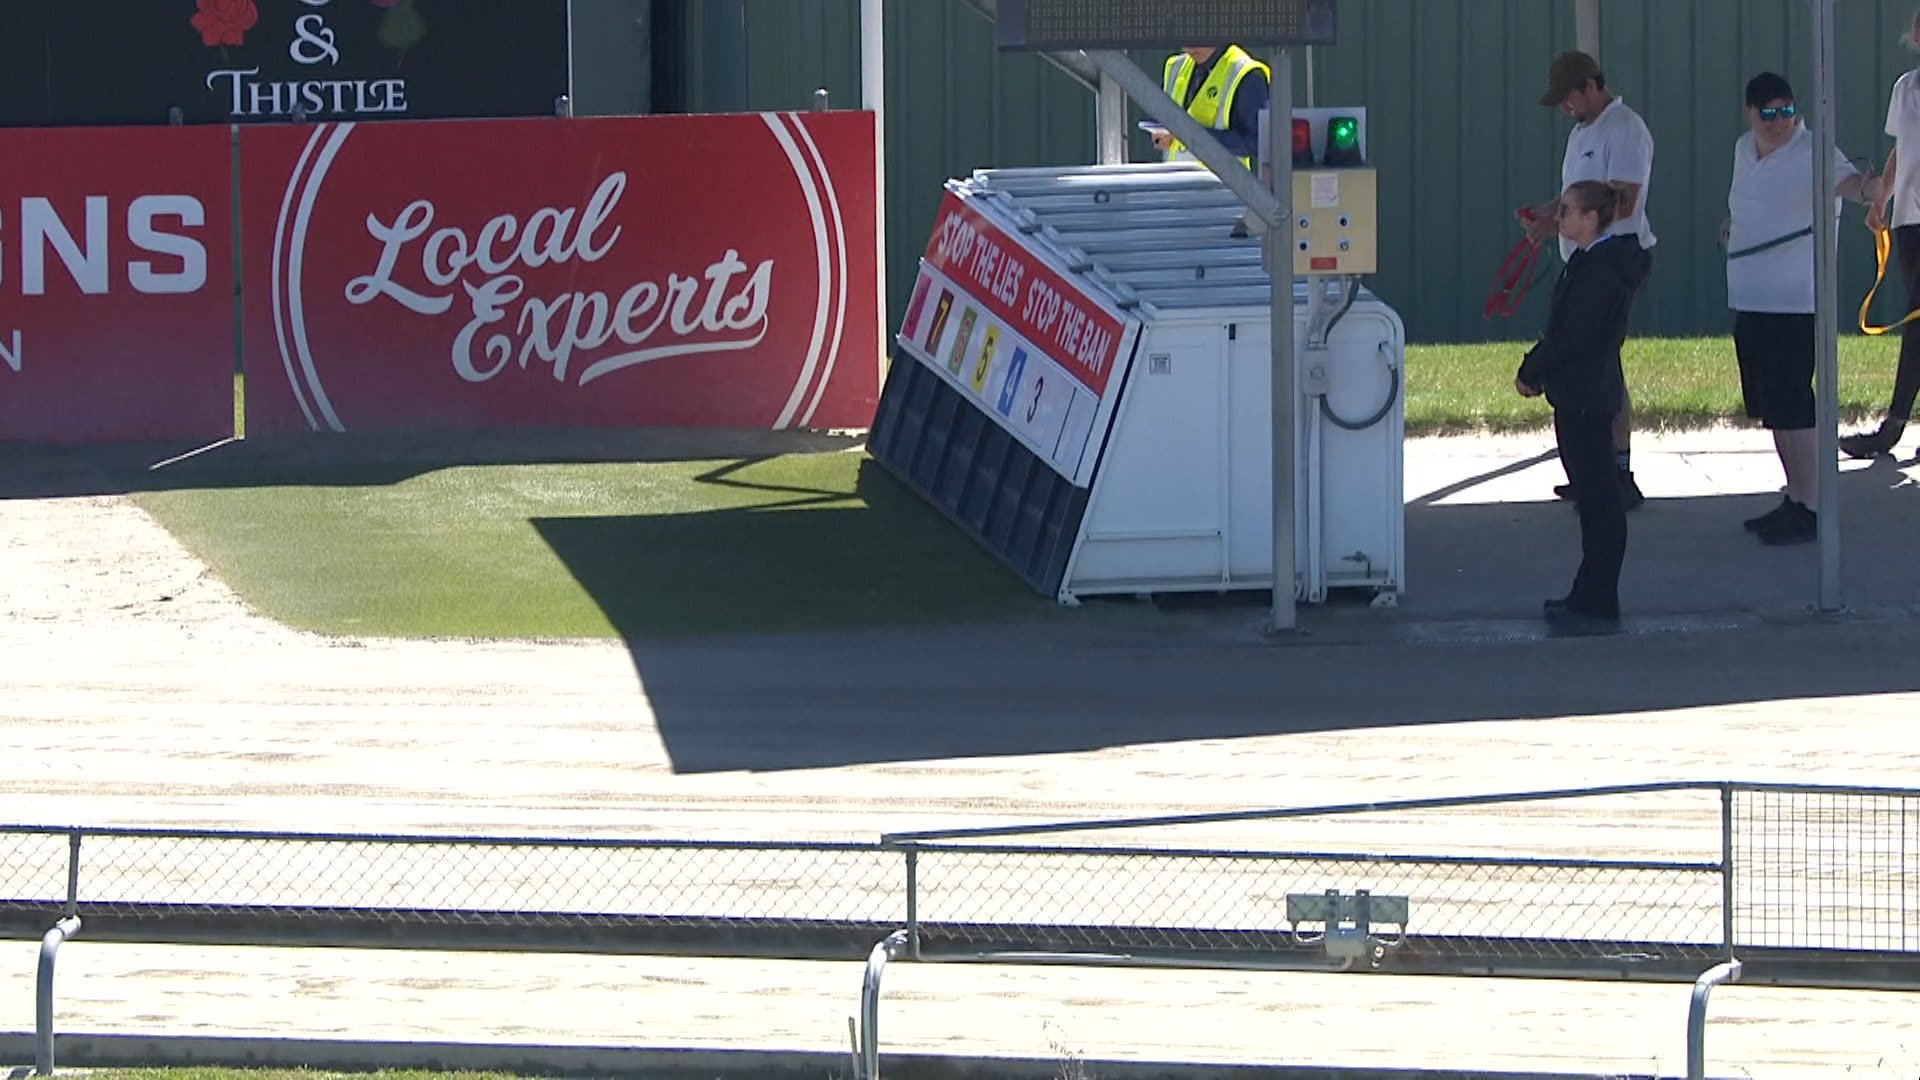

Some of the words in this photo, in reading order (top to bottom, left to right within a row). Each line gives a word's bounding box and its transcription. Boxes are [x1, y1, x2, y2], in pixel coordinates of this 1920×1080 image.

[206, 65, 408, 115] THISTLE
[289, 14, 339, 66] &
[0, 194, 207, 295] NS
[345, 171, 627, 314] Local
[938, 211, 976, 268] STOP
[968, 233, 1000, 289] THE
[991, 251, 1025, 308] LIES
[1022, 277, 1061, 334] STOP
[1055, 299, 1086, 356] THE
[1077, 317, 1112, 376] BAN
[452, 249, 774, 387] Experts
[930, 299, 949, 345] 7
[976, 336, 994, 382] 5
[1004, 359, 1021, 407] 4
[1026, 376, 1044, 423] 3
